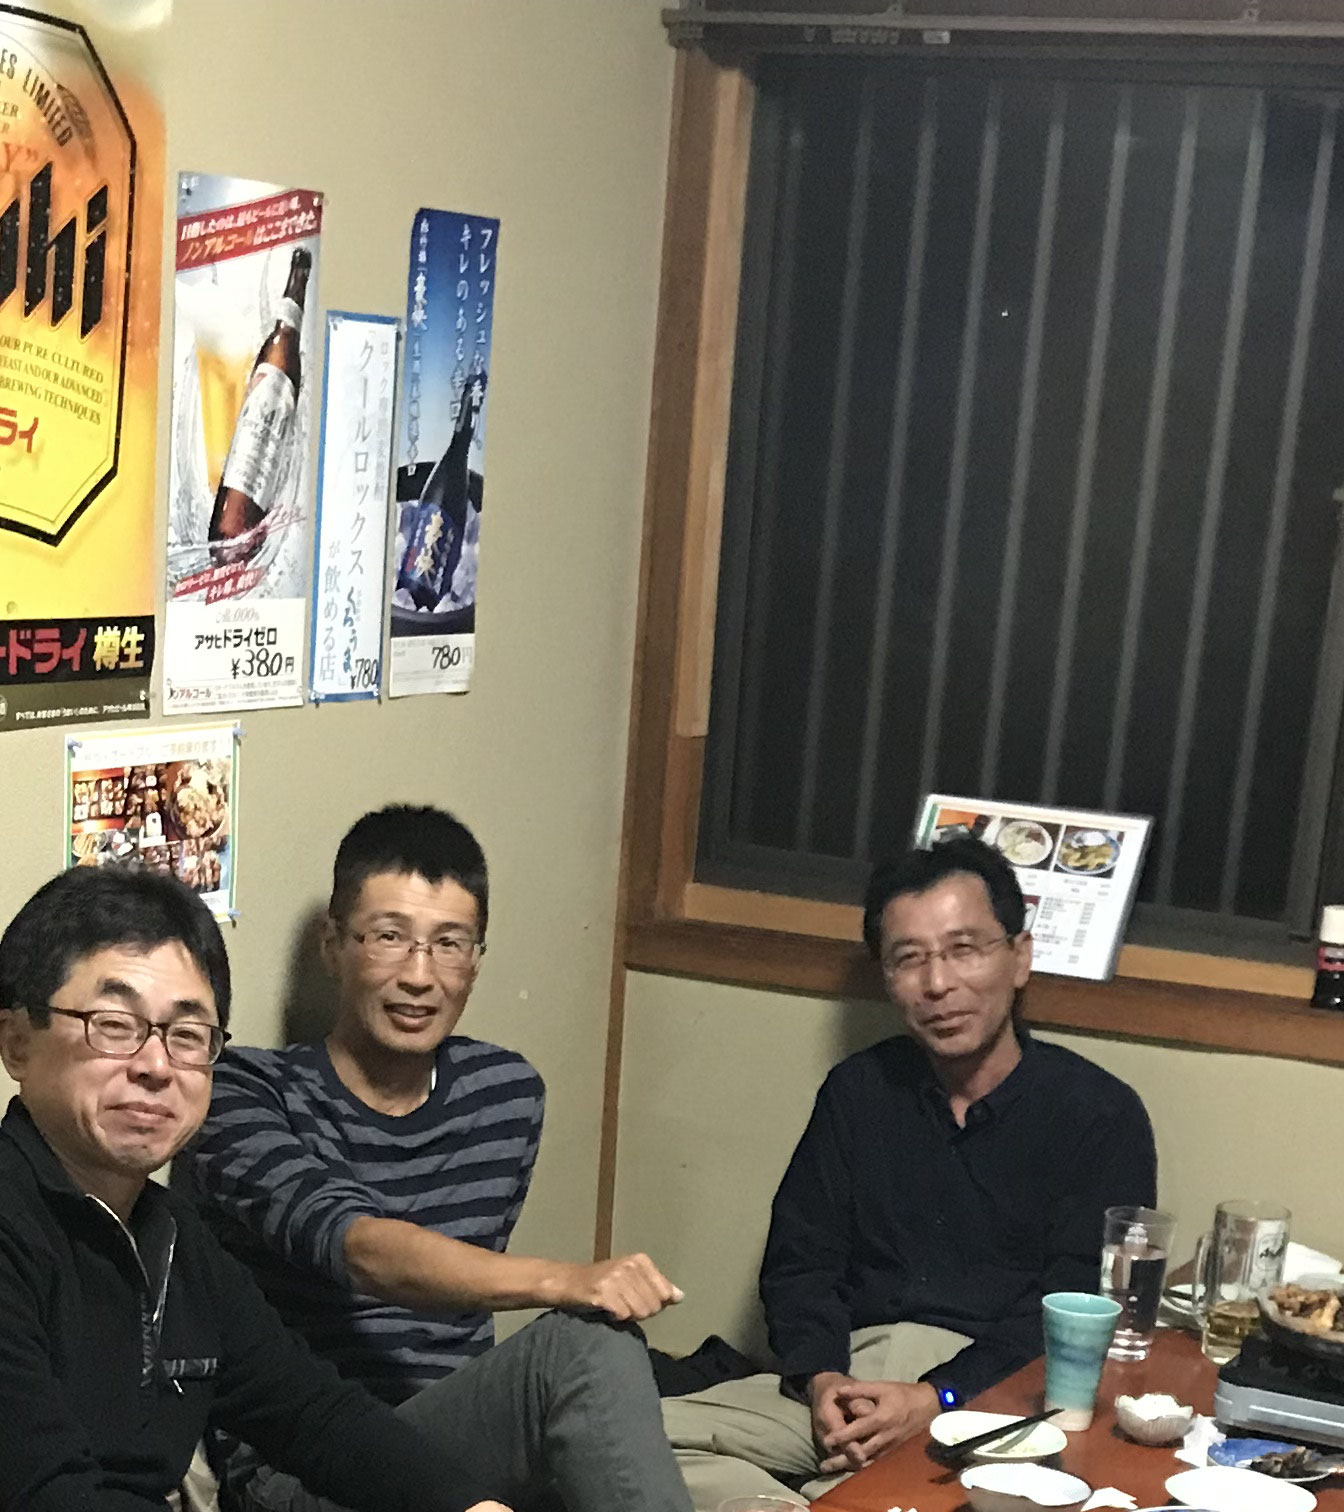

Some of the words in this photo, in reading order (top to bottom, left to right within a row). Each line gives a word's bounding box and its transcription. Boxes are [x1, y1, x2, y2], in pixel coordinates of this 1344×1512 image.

[22, 68, 74, 148] LIMITED
[22, 338, 50, 360] PURE
[50, 349, 105, 385] CULTURED
[23, 361, 42, 378] AND
[40, 366, 59, 386] OUR
[58, 371, 104, 406] ADVANCED
[42, 388, 102, 427] TECHNIQUES
[194, 627, 278, 650] アサヒドライゼロ
